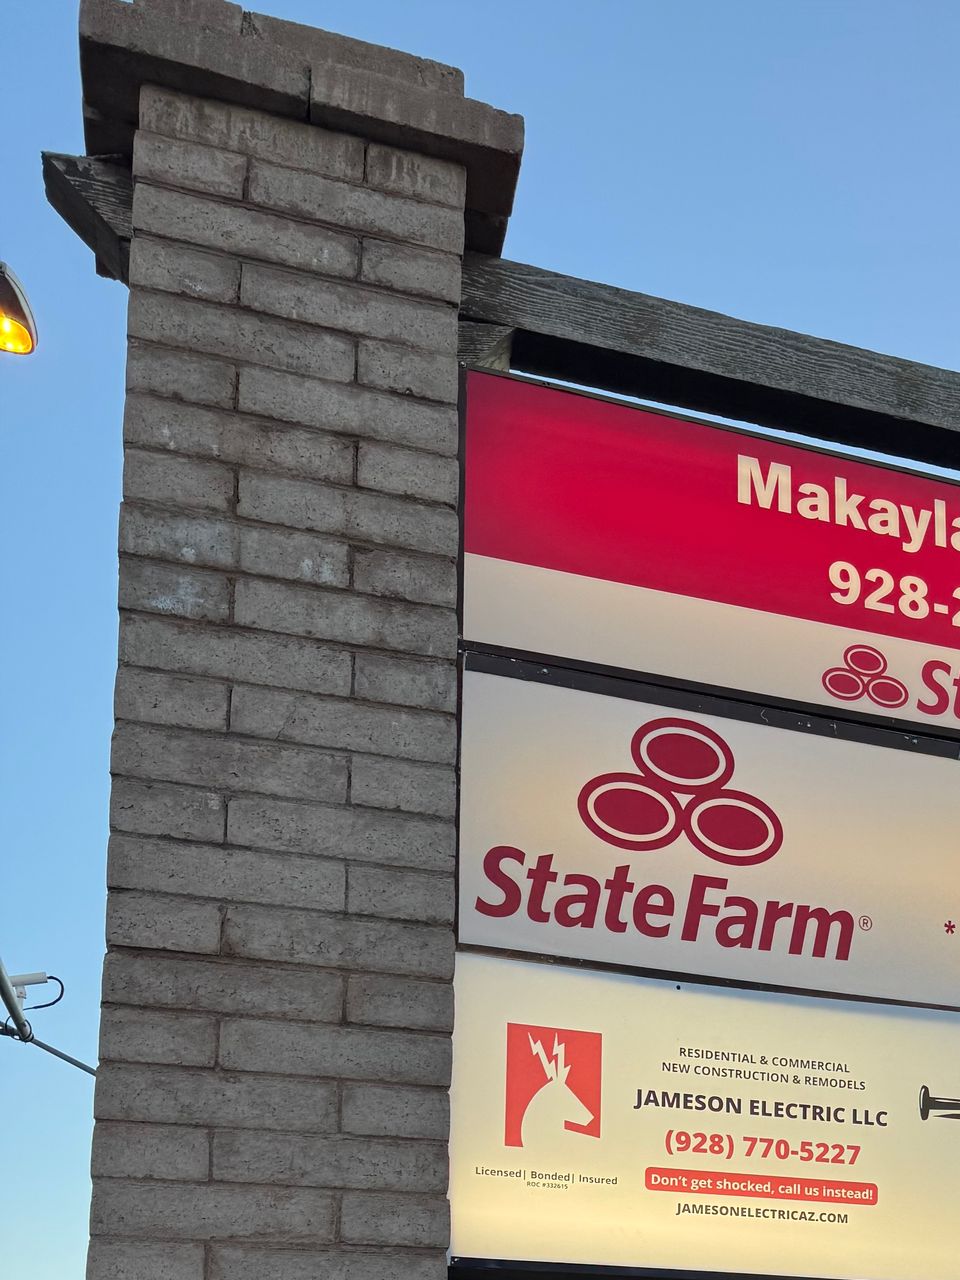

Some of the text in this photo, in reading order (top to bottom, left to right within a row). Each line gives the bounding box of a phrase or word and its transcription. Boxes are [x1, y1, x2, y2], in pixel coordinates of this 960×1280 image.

[679, 1047, 850, 1073] RESIDENTIAL & COMMERCIAL
[662, 1062, 866, 1090] NEW CONSTRUCTION & REMODELS
[634, 1089, 888, 1127] JAMESON ELECTRIC LLC
[665, 1129, 861, 1165] (928) 770-5227
[579, 1174, 618, 1185] Insured
[651, 1173, 873, 1200] Don't get shocked, call us instead!
[676, 1202, 848, 1223] JAMESONELECTRICAZ.COM
